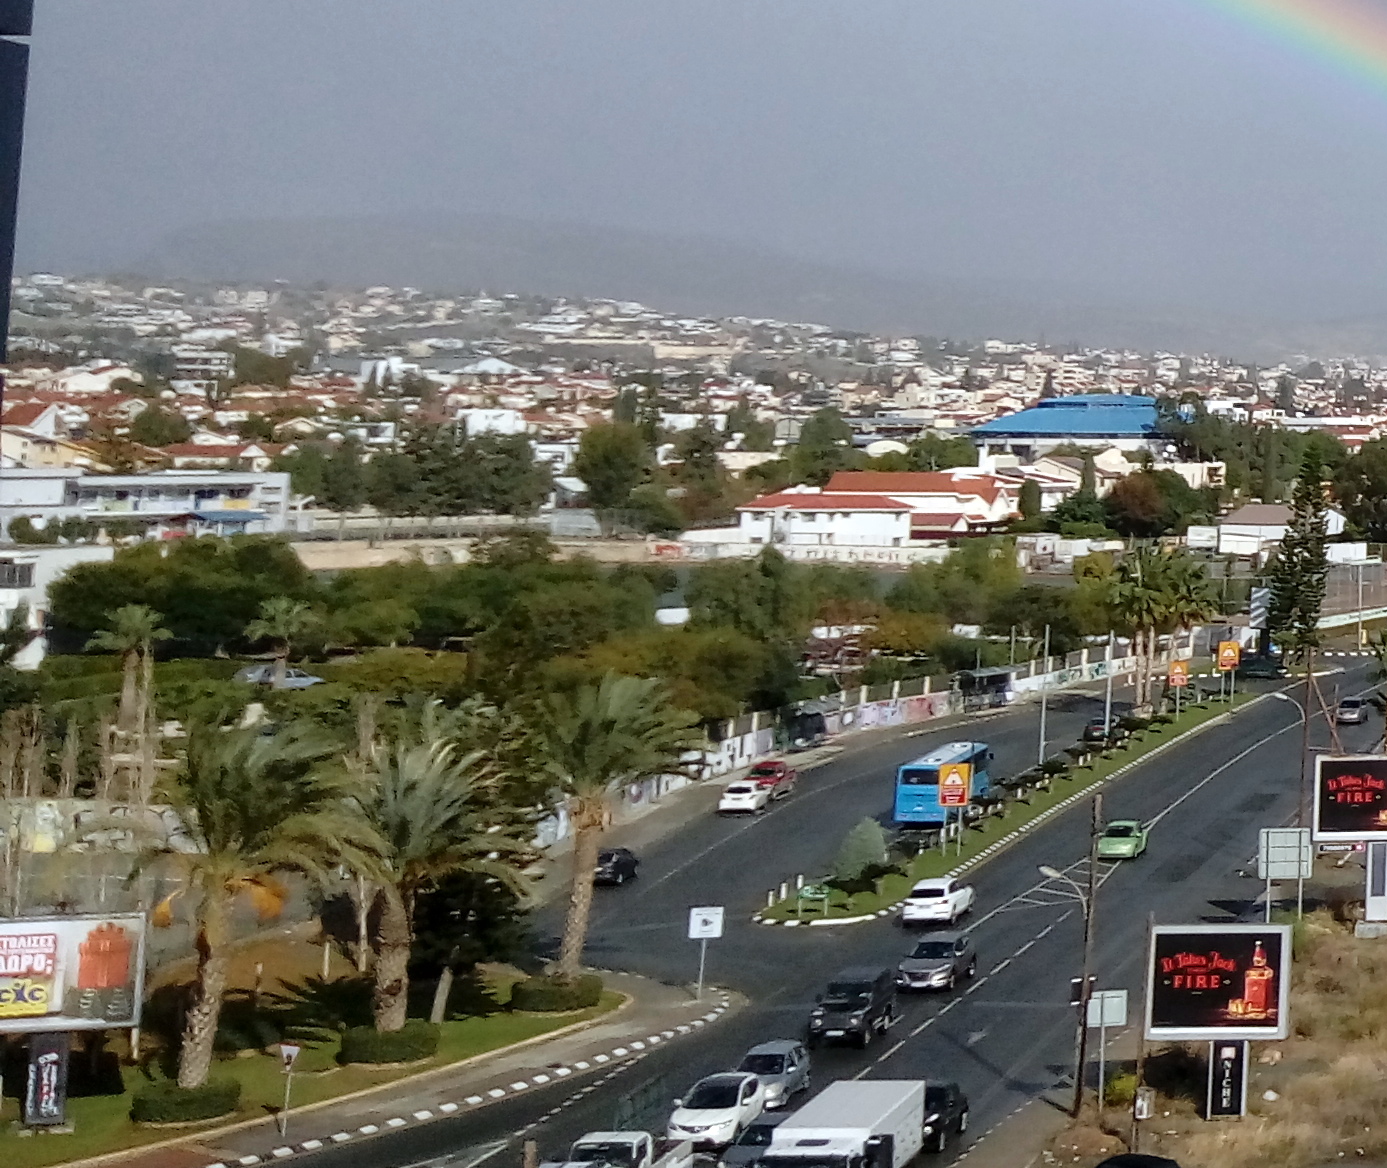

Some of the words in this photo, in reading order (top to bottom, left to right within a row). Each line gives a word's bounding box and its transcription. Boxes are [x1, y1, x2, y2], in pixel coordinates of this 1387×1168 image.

[1363, 774, 1385, 789] Jack
[1337, 792, 1373, 803] FIRE
[1210, 951, 1236, 971] Jack
[1173, 975, 1220, 989] FIRE
[1222, 1060, 1231, 1108] NICHE
